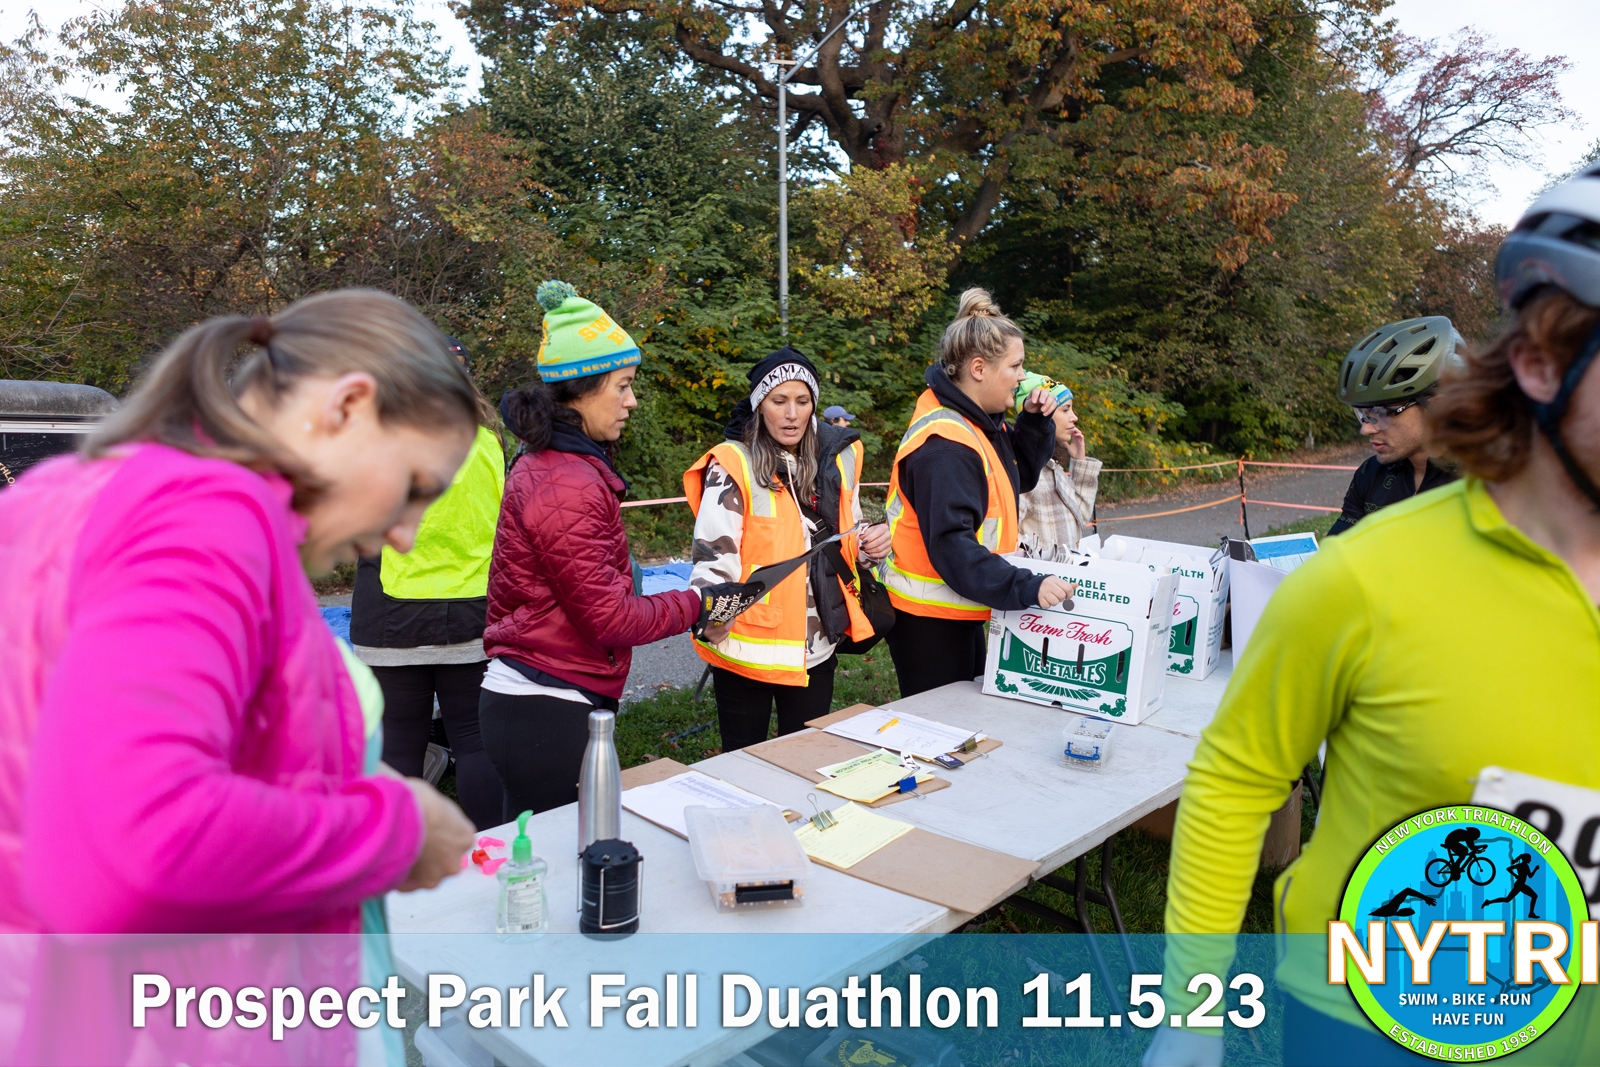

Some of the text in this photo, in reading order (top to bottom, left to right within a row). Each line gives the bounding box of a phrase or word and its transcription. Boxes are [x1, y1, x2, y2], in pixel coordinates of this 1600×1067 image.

[577, 314, 612, 342] SW
[582, 361, 611, 373] NEW
[1037, 572, 1107, 591] SHABLE
[1171, 567, 1205, 579] EALTH
[1073, 588, 1131, 605] IGERATED
[1018, 613, 1065, 637] Farm
[1066, 621, 1113, 646] Fresh
[1022, 647, 1107, 686] VEGETABLES
